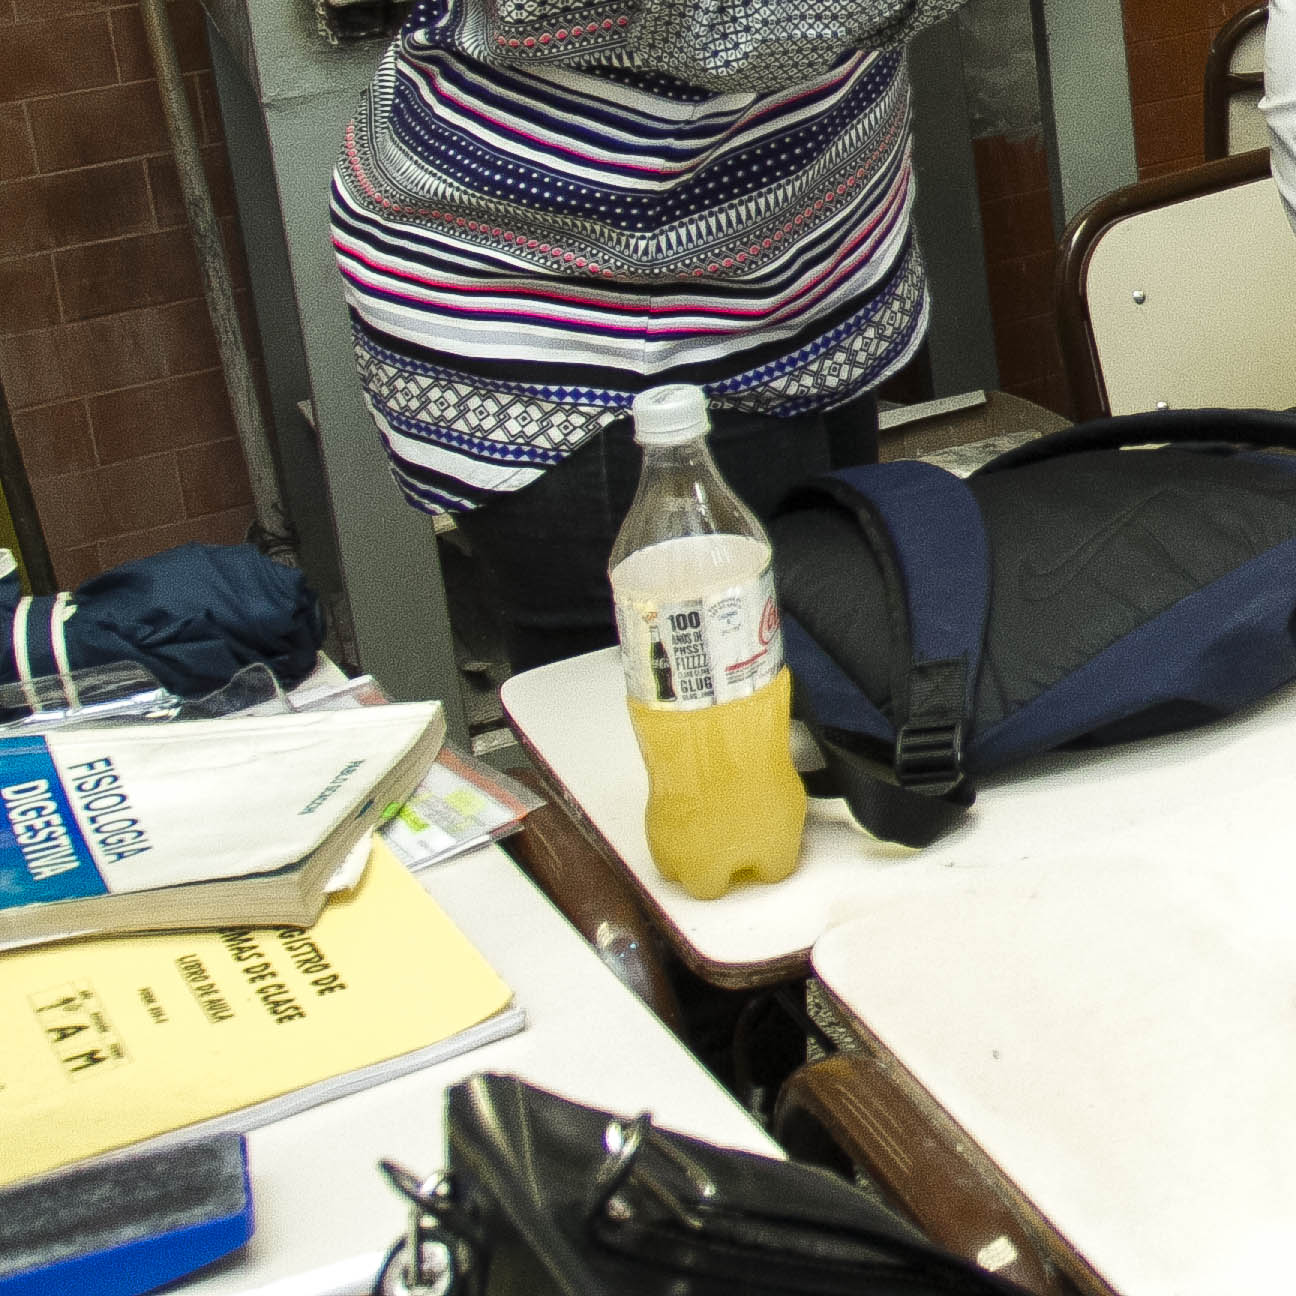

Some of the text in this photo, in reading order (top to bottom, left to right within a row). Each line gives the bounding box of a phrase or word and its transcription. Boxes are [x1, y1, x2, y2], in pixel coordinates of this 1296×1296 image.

[667, 611, 701, 632] 100
[1, 778, 81, 881] DIGESTIVA
[176, 953, 236, 1024] LIBRO DE AULA
[242, 961, 278, 984] DE
[310, 973, 348, 997] DE
[255, 982, 307, 1024] CLASE
